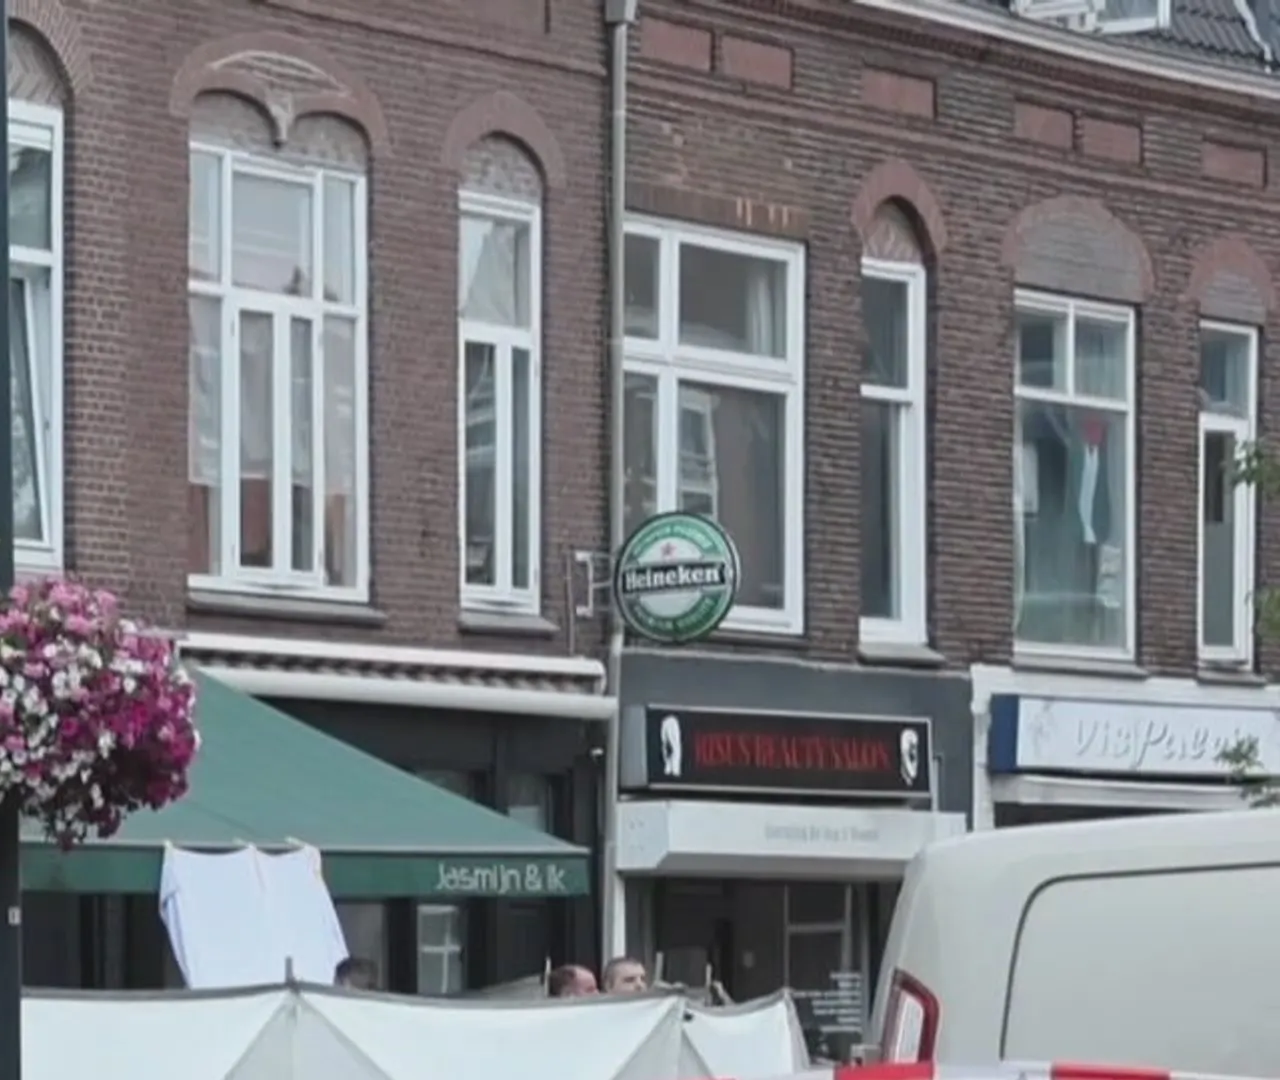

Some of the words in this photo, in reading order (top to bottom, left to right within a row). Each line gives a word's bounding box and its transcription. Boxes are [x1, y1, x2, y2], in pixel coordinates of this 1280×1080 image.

[624, 565, 721, 592] Heineken
[436, 862, 522, 895] Jasmijn
[524, 863, 542, 892] &
